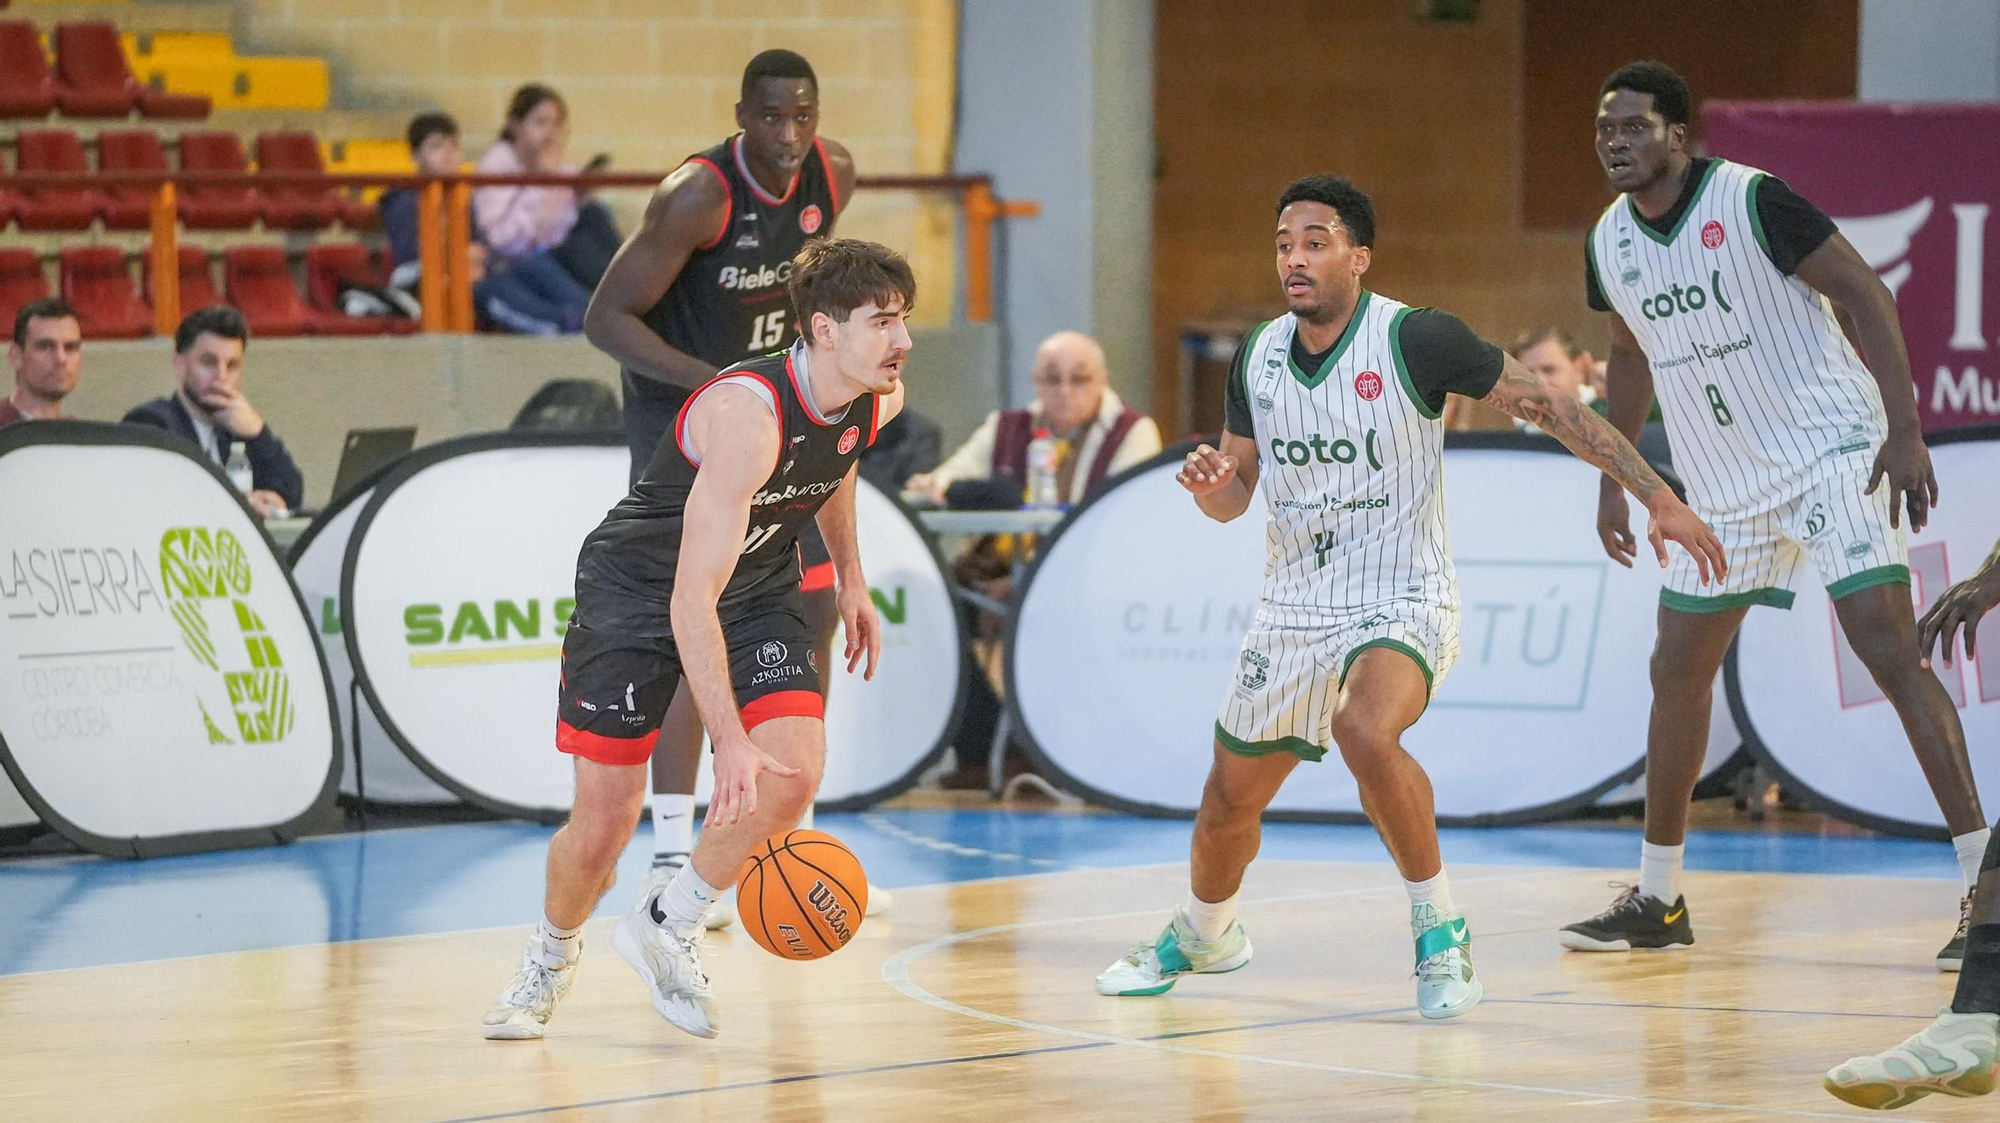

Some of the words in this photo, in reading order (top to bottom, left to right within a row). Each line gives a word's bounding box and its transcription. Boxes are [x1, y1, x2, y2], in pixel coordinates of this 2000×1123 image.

[718, 260, 792, 290] BieleG
[747, 309, 786, 351] 15
[1653, 354, 1695, 370] Fundación
[1701, 333, 1753, 360] Cajasol
[1705, 383, 1734, 426] 8
[1330, 493, 1390, 513] Cajasol
[1314, 531, 1335, 569] 4
[403, 598, 541, 645] SAN
[1122, 596, 1255, 633] CLÍN
[1473, 584, 1571, 667] TÚ
[22, 664, 90, 700] CENTRO
[751, 665, 804, 687] AZKOITIA
[807, 879, 852, 946] Wilson
